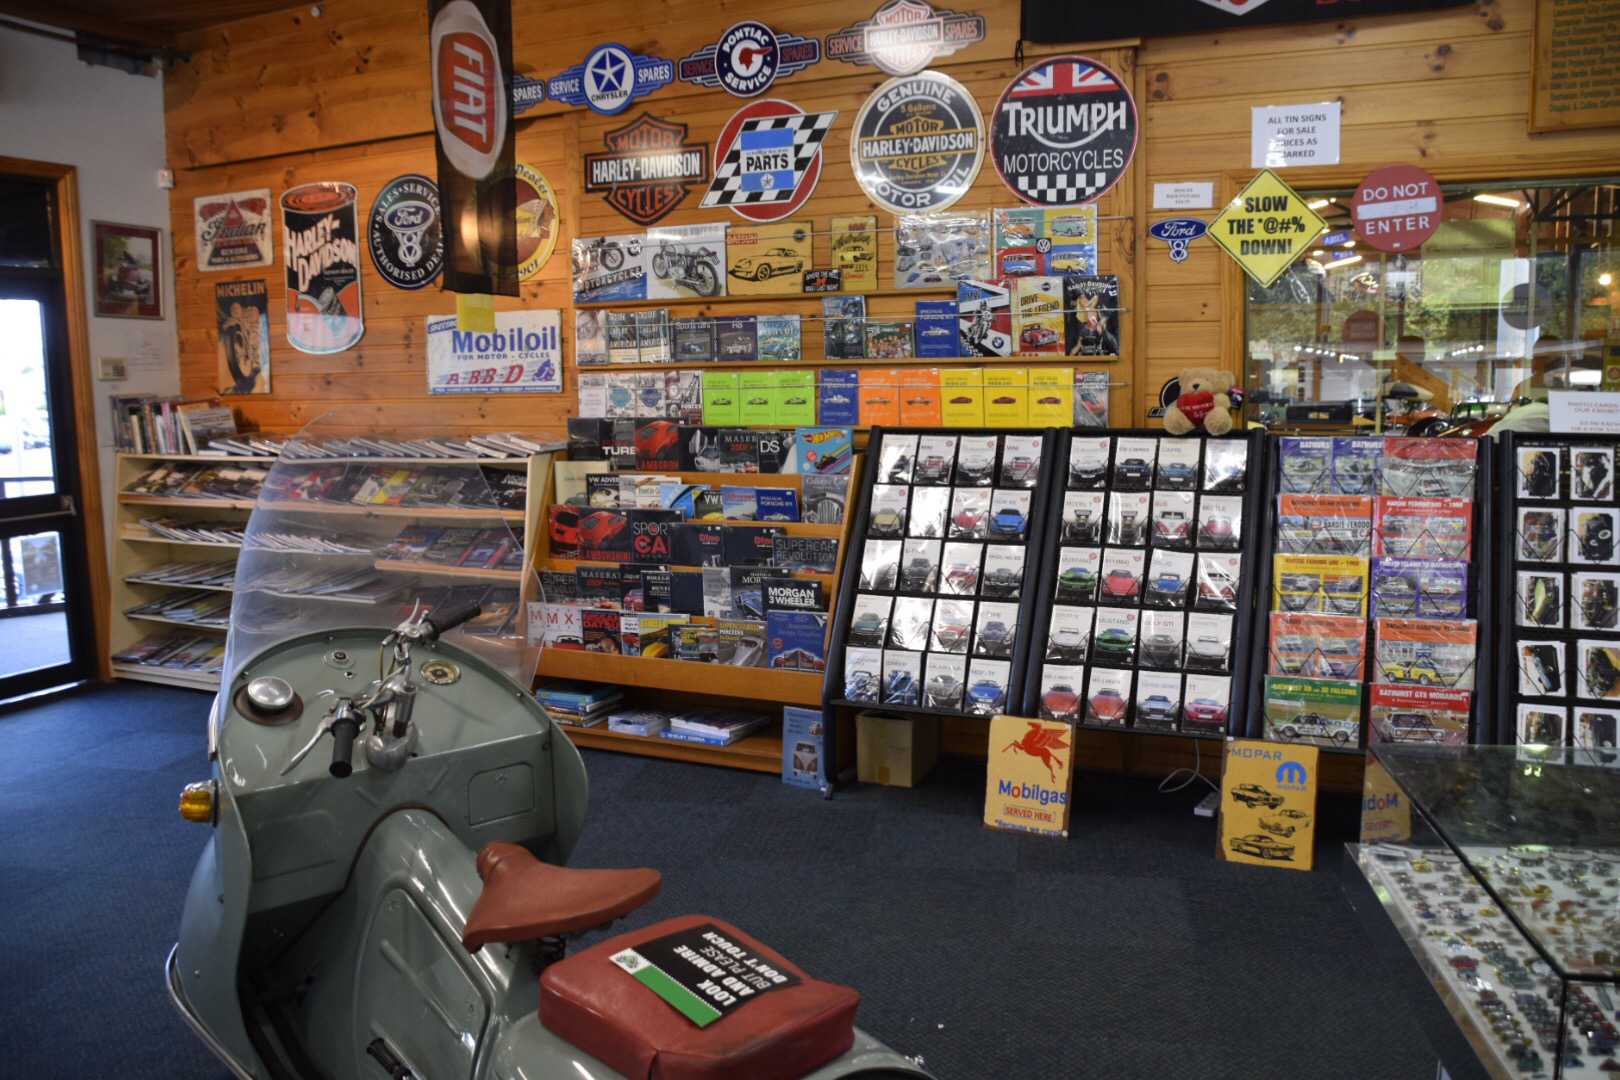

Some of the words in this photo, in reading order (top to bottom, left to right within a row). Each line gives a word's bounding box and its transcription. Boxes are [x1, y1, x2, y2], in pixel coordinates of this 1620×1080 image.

[945, 21, 978, 38] SPARES
[723, 27, 770, 53] PONTIAC
[829, 36, 862, 54] SERVICE
[638, 64, 670, 83] SPARES
[724, 65, 772, 90] SERVICE
[453, 42, 488, 144] FIAT
[513, 84, 543, 100] SPARES
[550, 78, 580, 95] SERVICE
[591, 90, 628, 102] CHRYSLER
[877, 80, 957, 112] GENUINE
[895, 119, 939, 134] MOTOR
[1002, 101, 1127, 141] TRIUMPH
[1267, 117, 1282, 125] ALL
[1284, 115, 1300, 123] TIN
[1301, 113, 1327, 122] SIGNS
[617, 130, 674, 149] MOTOR
[1276, 127, 1294, 135] FOR
[1296, 126, 1316, 134] SALE
[863, 132, 973, 157] HARLEY-DAVIDSON
[1278, 138, 1304, 146] RICES
[746, 153, 789, 171] PARTS
[895, 155, 941, 169] CYCLES
[1003, 149, 1124, 174] MOTORCYCLES
[1279, 150, 1315, 158] ARKED
[592, 152, 700, 183] HARLEY-DAVIDSON
[617, 185, 674, 212] CYCLES
[1362, 187, 1388, 202] DO
[1392, 182, 1429, 198] NOT
[376, 188, 400, 222] SALES
[1245, 196, 1288, 213] SLOW
[394, 207, 422, 225] Ford
[1160, 221, 1196, 237] Ford
[1227, 218, 1254, 235] THE
[1365, 216, 1430, 236] ENTER
[285, 213, 340, 273] HARLEY-
[1240, 238, 1292, 256] DOWN!
[297, 237, 357, 293] DAVIDSON
[373, 232, 425, 281] AUTHORISED
[217, 283, 265, 298] MICHELIN
[1020, 294, 1039, 306] DRIVE
[1034, 302, 1060, 314] LEGEND
[452, 326, 556, 353] Mobiloil
[518, 352, 550, 360] CYCLES
[760, 440, 780, 453] DS
[634, 534, 671, 554] CA
[774, 538, 834, 551] SUPERCAR
[775, 550, 836, 562] REVOLUTION
[768, 587, 815, 598] MORGAN
[768, 596, 775, 604] 3
[775, 597, 816, 607] WHEELER
[1231, 748, 1283, 761] MOPAR
[998, 779, 1070, 805] Mobilgas
[1006, 806, 1033, 818] SERVED
[1034, 810, 1053, 821] HERE
[701, 931, 748, 958] TOUCH
[673, 944, 727, 978] ADMIRE
[700, 945, 742, 974] PLEASE
[743, 957, 788, 984] DON'T
[721, 975, 756, 997] AND
[741, 974, 772, 990] BUT
[696, 978, 737, 1007] LOOK
